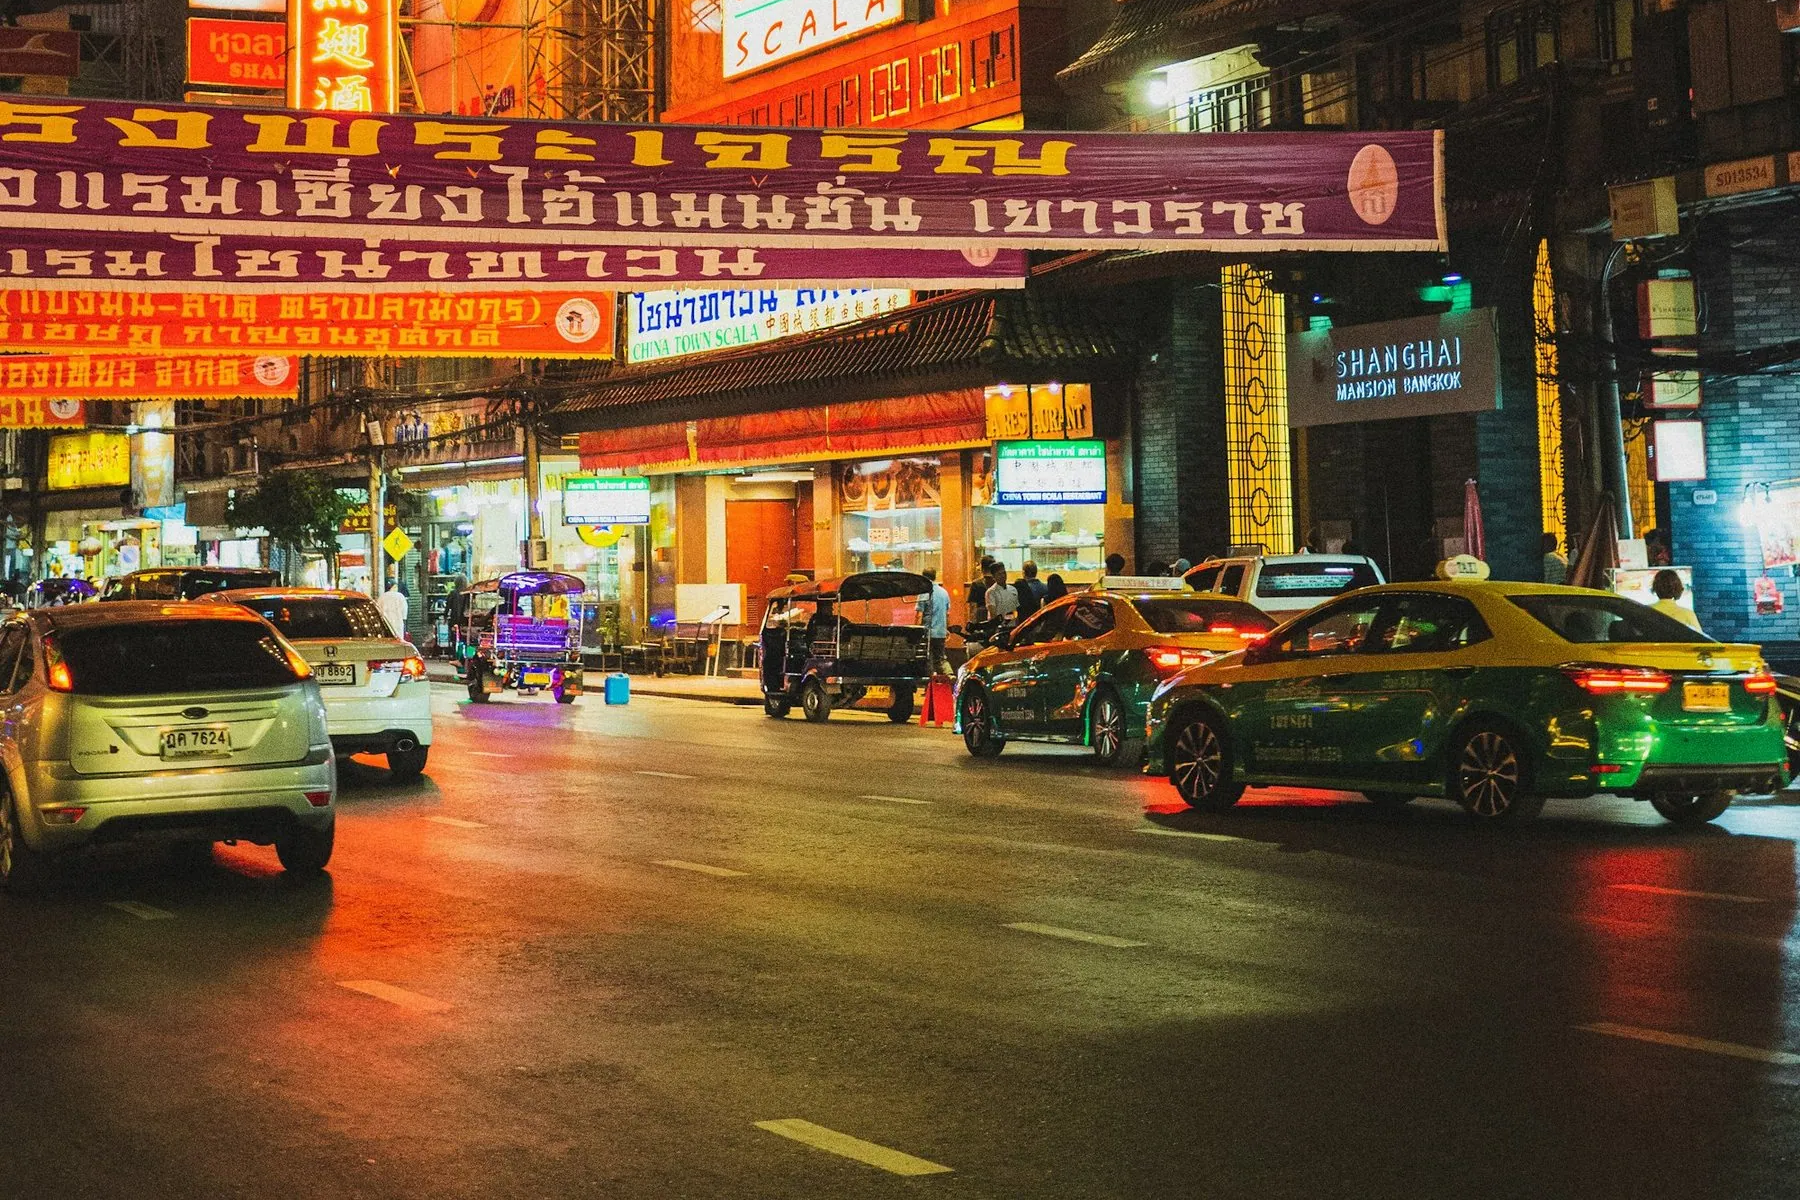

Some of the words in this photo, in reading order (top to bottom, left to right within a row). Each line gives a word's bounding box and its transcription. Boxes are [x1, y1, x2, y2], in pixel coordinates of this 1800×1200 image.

[970, 198, 1305, 235] เยาวราช
[633, 338, 670, 361] CHINA
[675, 332, 713, 353] TOWN
[716, 323, 760, 348] SCALA
[1336, 337, 1462, 378] SHANGHAI
[1336, 378, 1396, 401] MANSION
[1403, 371, 1462, 393] BANGKOK
[1002, 493, 1022, 501] CHINA
[1042, 492, 1063, 501] SCALA
[327, 666, 352, 677] 8892
[191, 730, 226, 746] 7624
